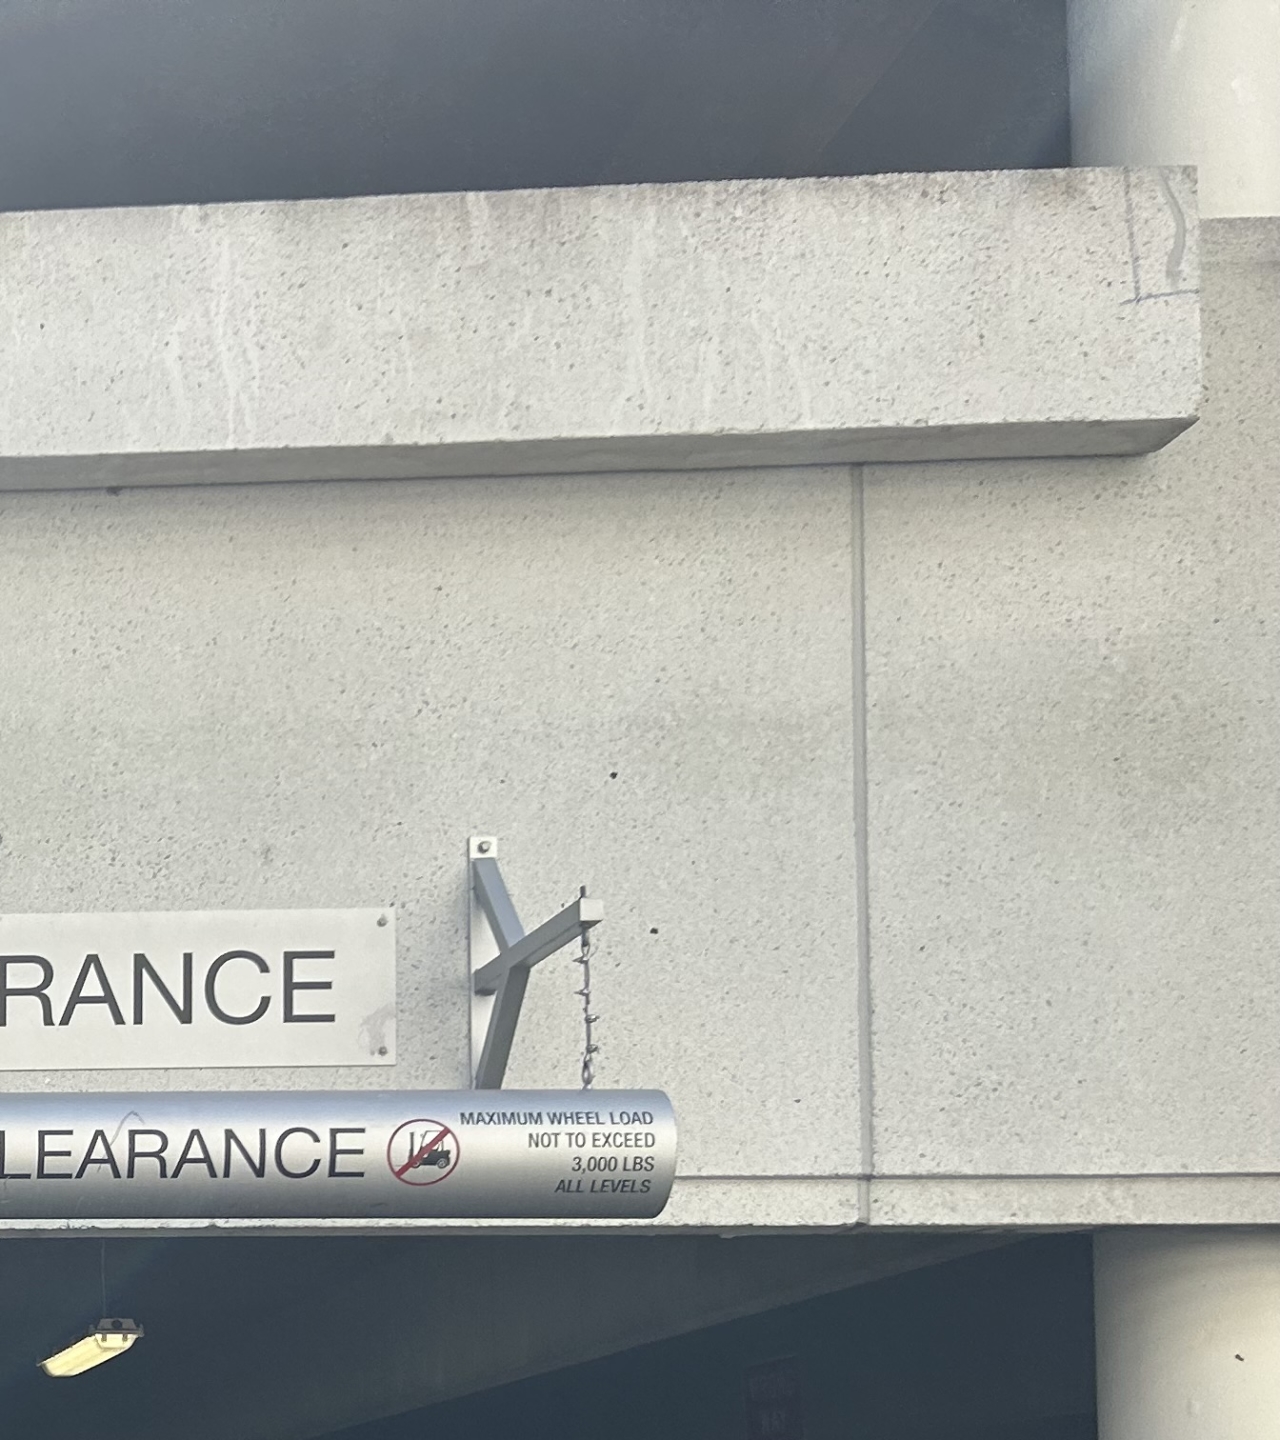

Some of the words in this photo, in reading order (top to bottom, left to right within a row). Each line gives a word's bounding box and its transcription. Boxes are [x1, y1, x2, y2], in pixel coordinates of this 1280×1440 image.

[459, 1111, 543, 1126] MAXIMUM
[547, 1111, 606, 1126] WHEEL
[609, 1111, 654, 1126] LOAD
[528, 1132, 561, 1148] NOT
[567, 1132, 586, 1148] TO
[591, 1132, 656, 1148] EXCEED
[571, 1156, 618, 1175] 3,000
[622, 1156, 655, 1172] LBS
[554, 1179, 585, 1194] ALL
[590, 1179, 652, 1194] LEVELS
